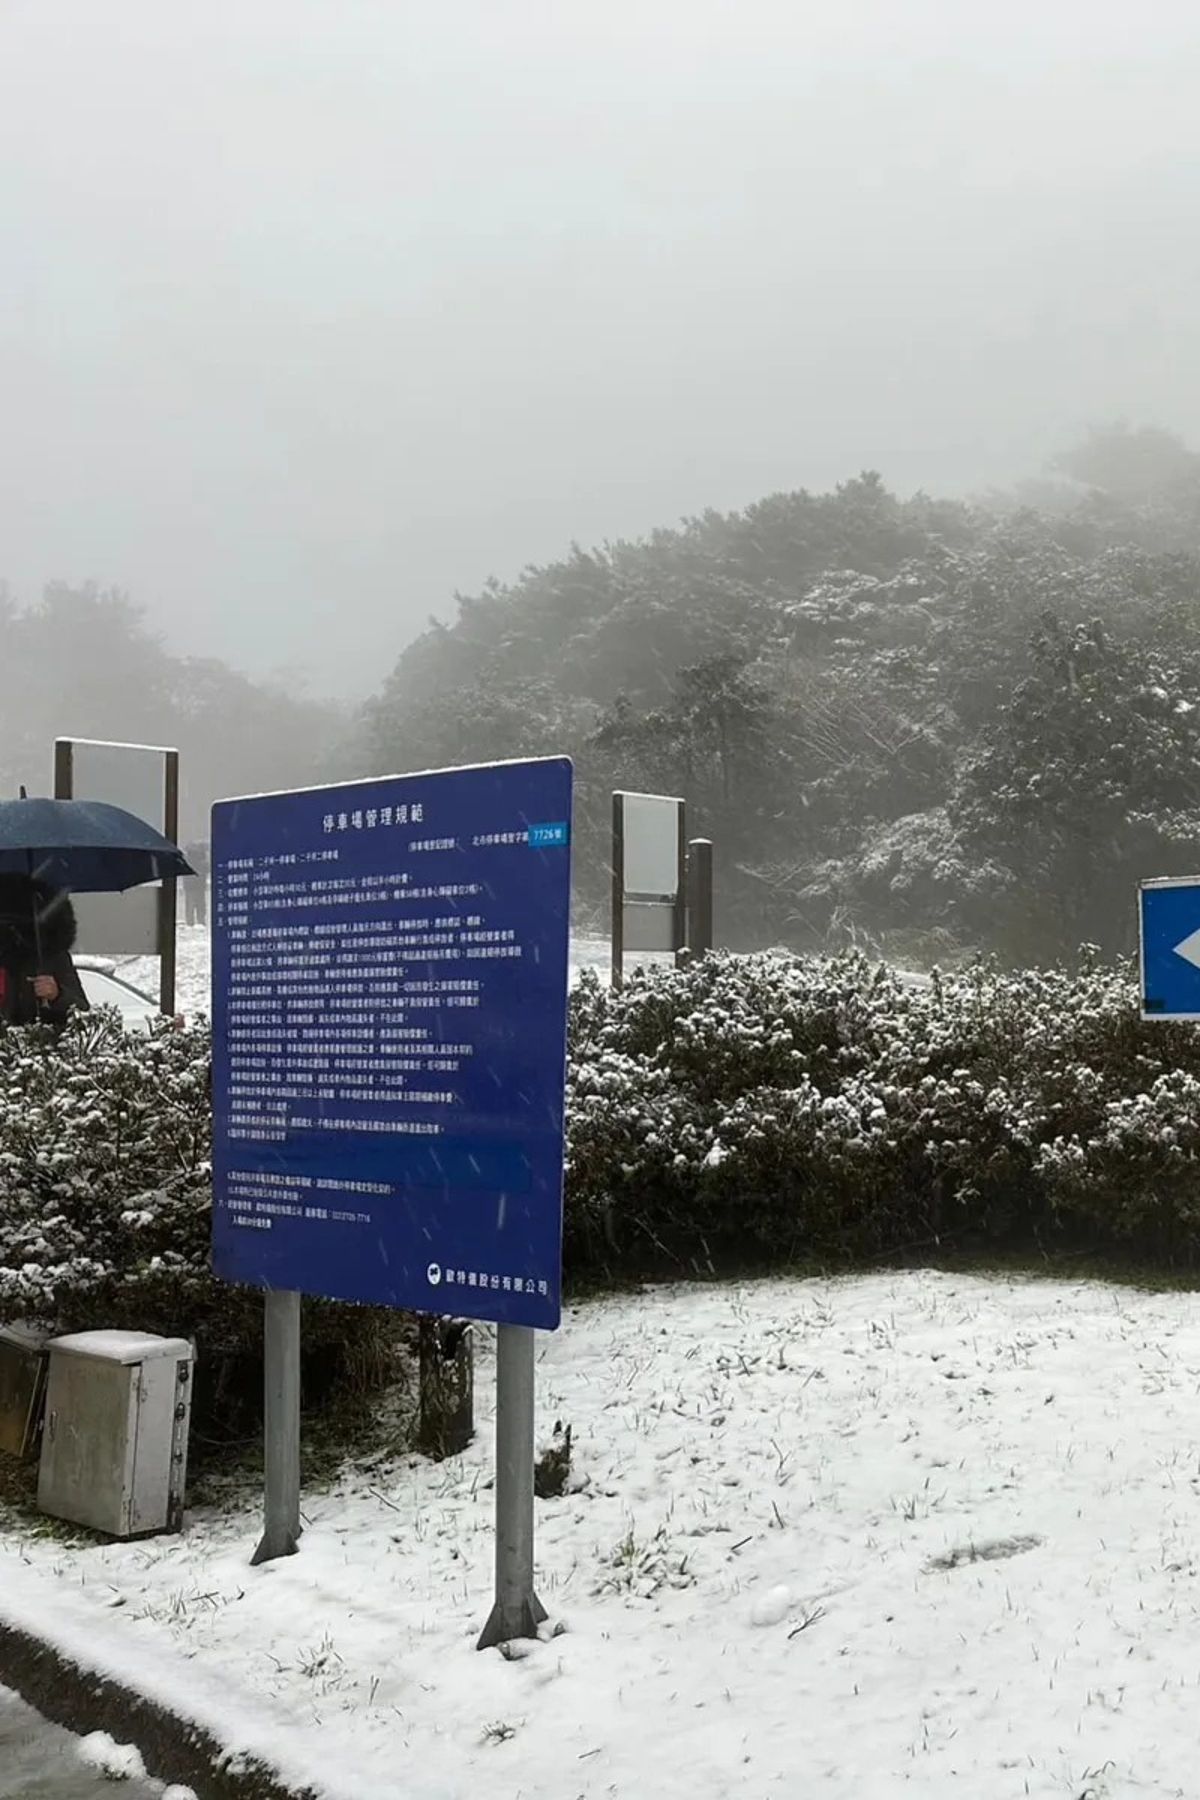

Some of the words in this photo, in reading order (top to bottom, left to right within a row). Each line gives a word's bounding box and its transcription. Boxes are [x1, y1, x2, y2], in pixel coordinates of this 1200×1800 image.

[323, 803, 424, 833] 停車場管理規範
